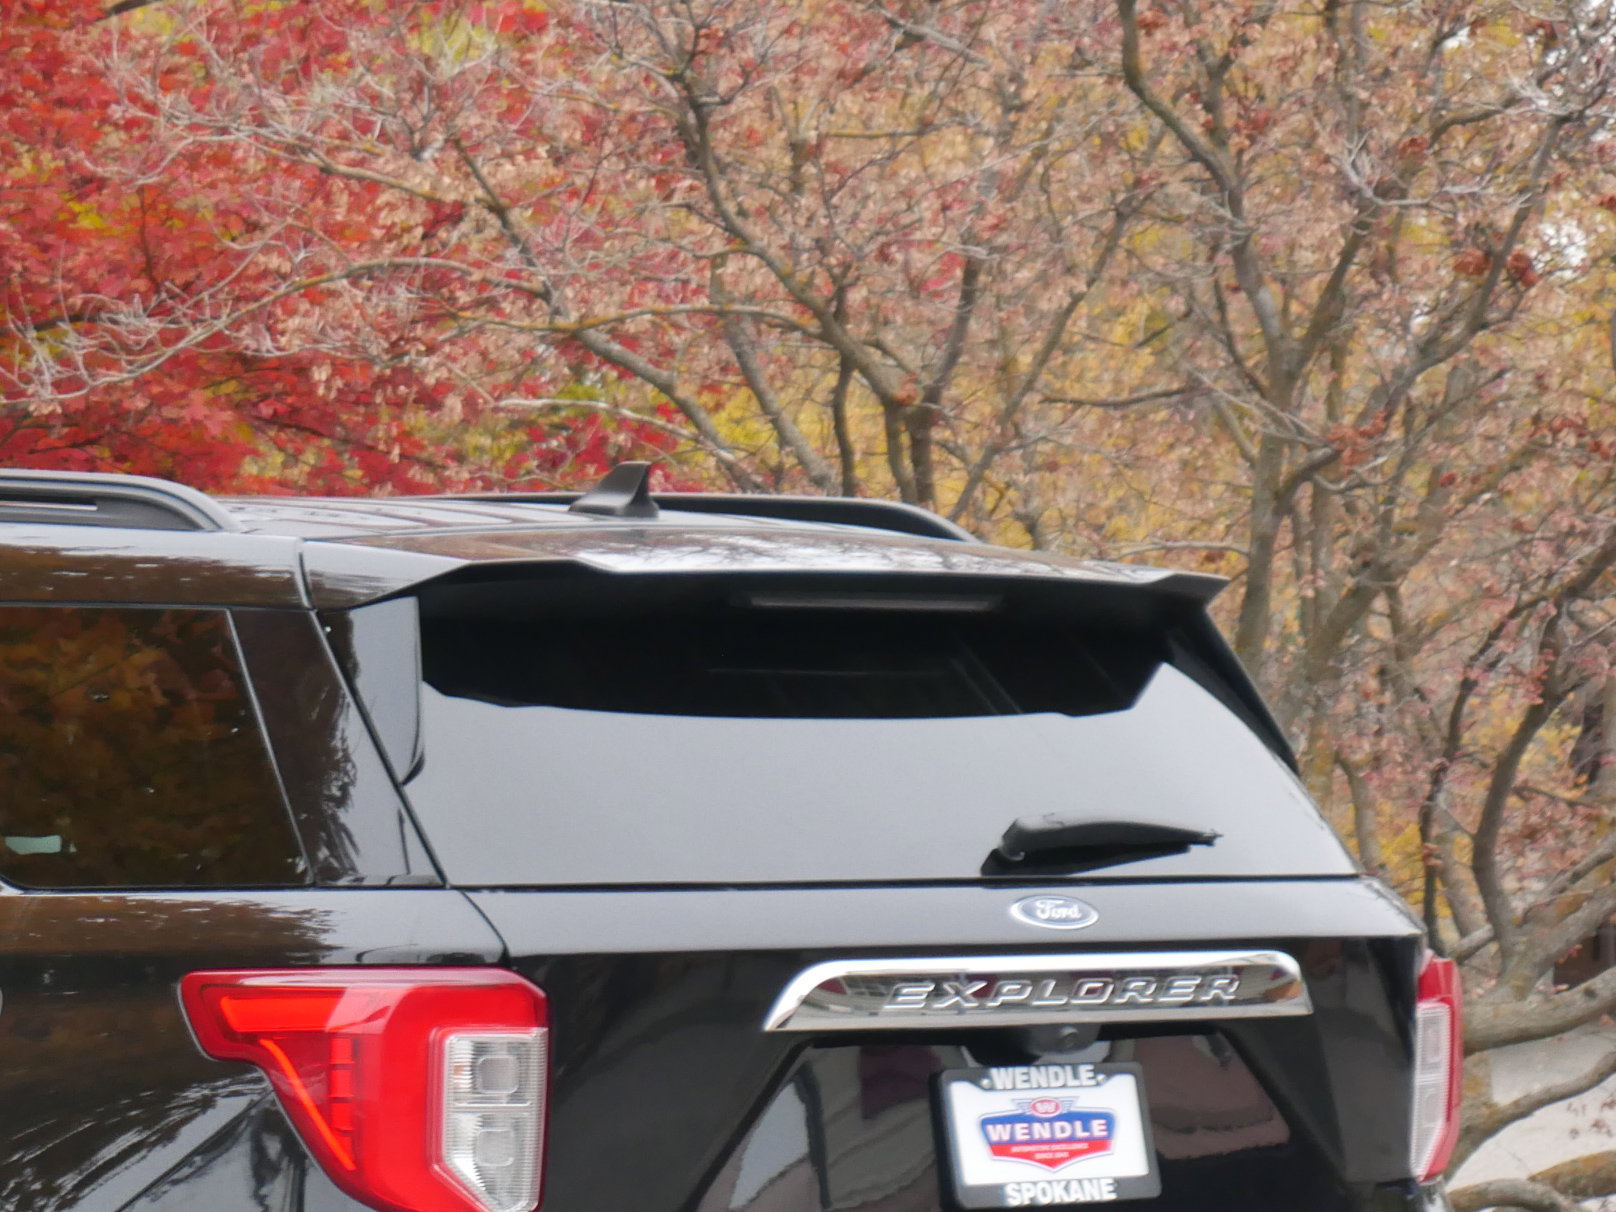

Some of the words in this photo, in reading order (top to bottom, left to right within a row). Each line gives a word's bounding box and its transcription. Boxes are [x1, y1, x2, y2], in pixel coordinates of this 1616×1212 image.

[1035, 899, 1083, 920] Ford
[883, 974, 1241, 1009] EXPLORER
[990, 1064, 1097, 1090] WENDLE
[986, 1119, 1109, 1141] WENDLE
[1004, 1178, 1118, 1206] SPOKANE
